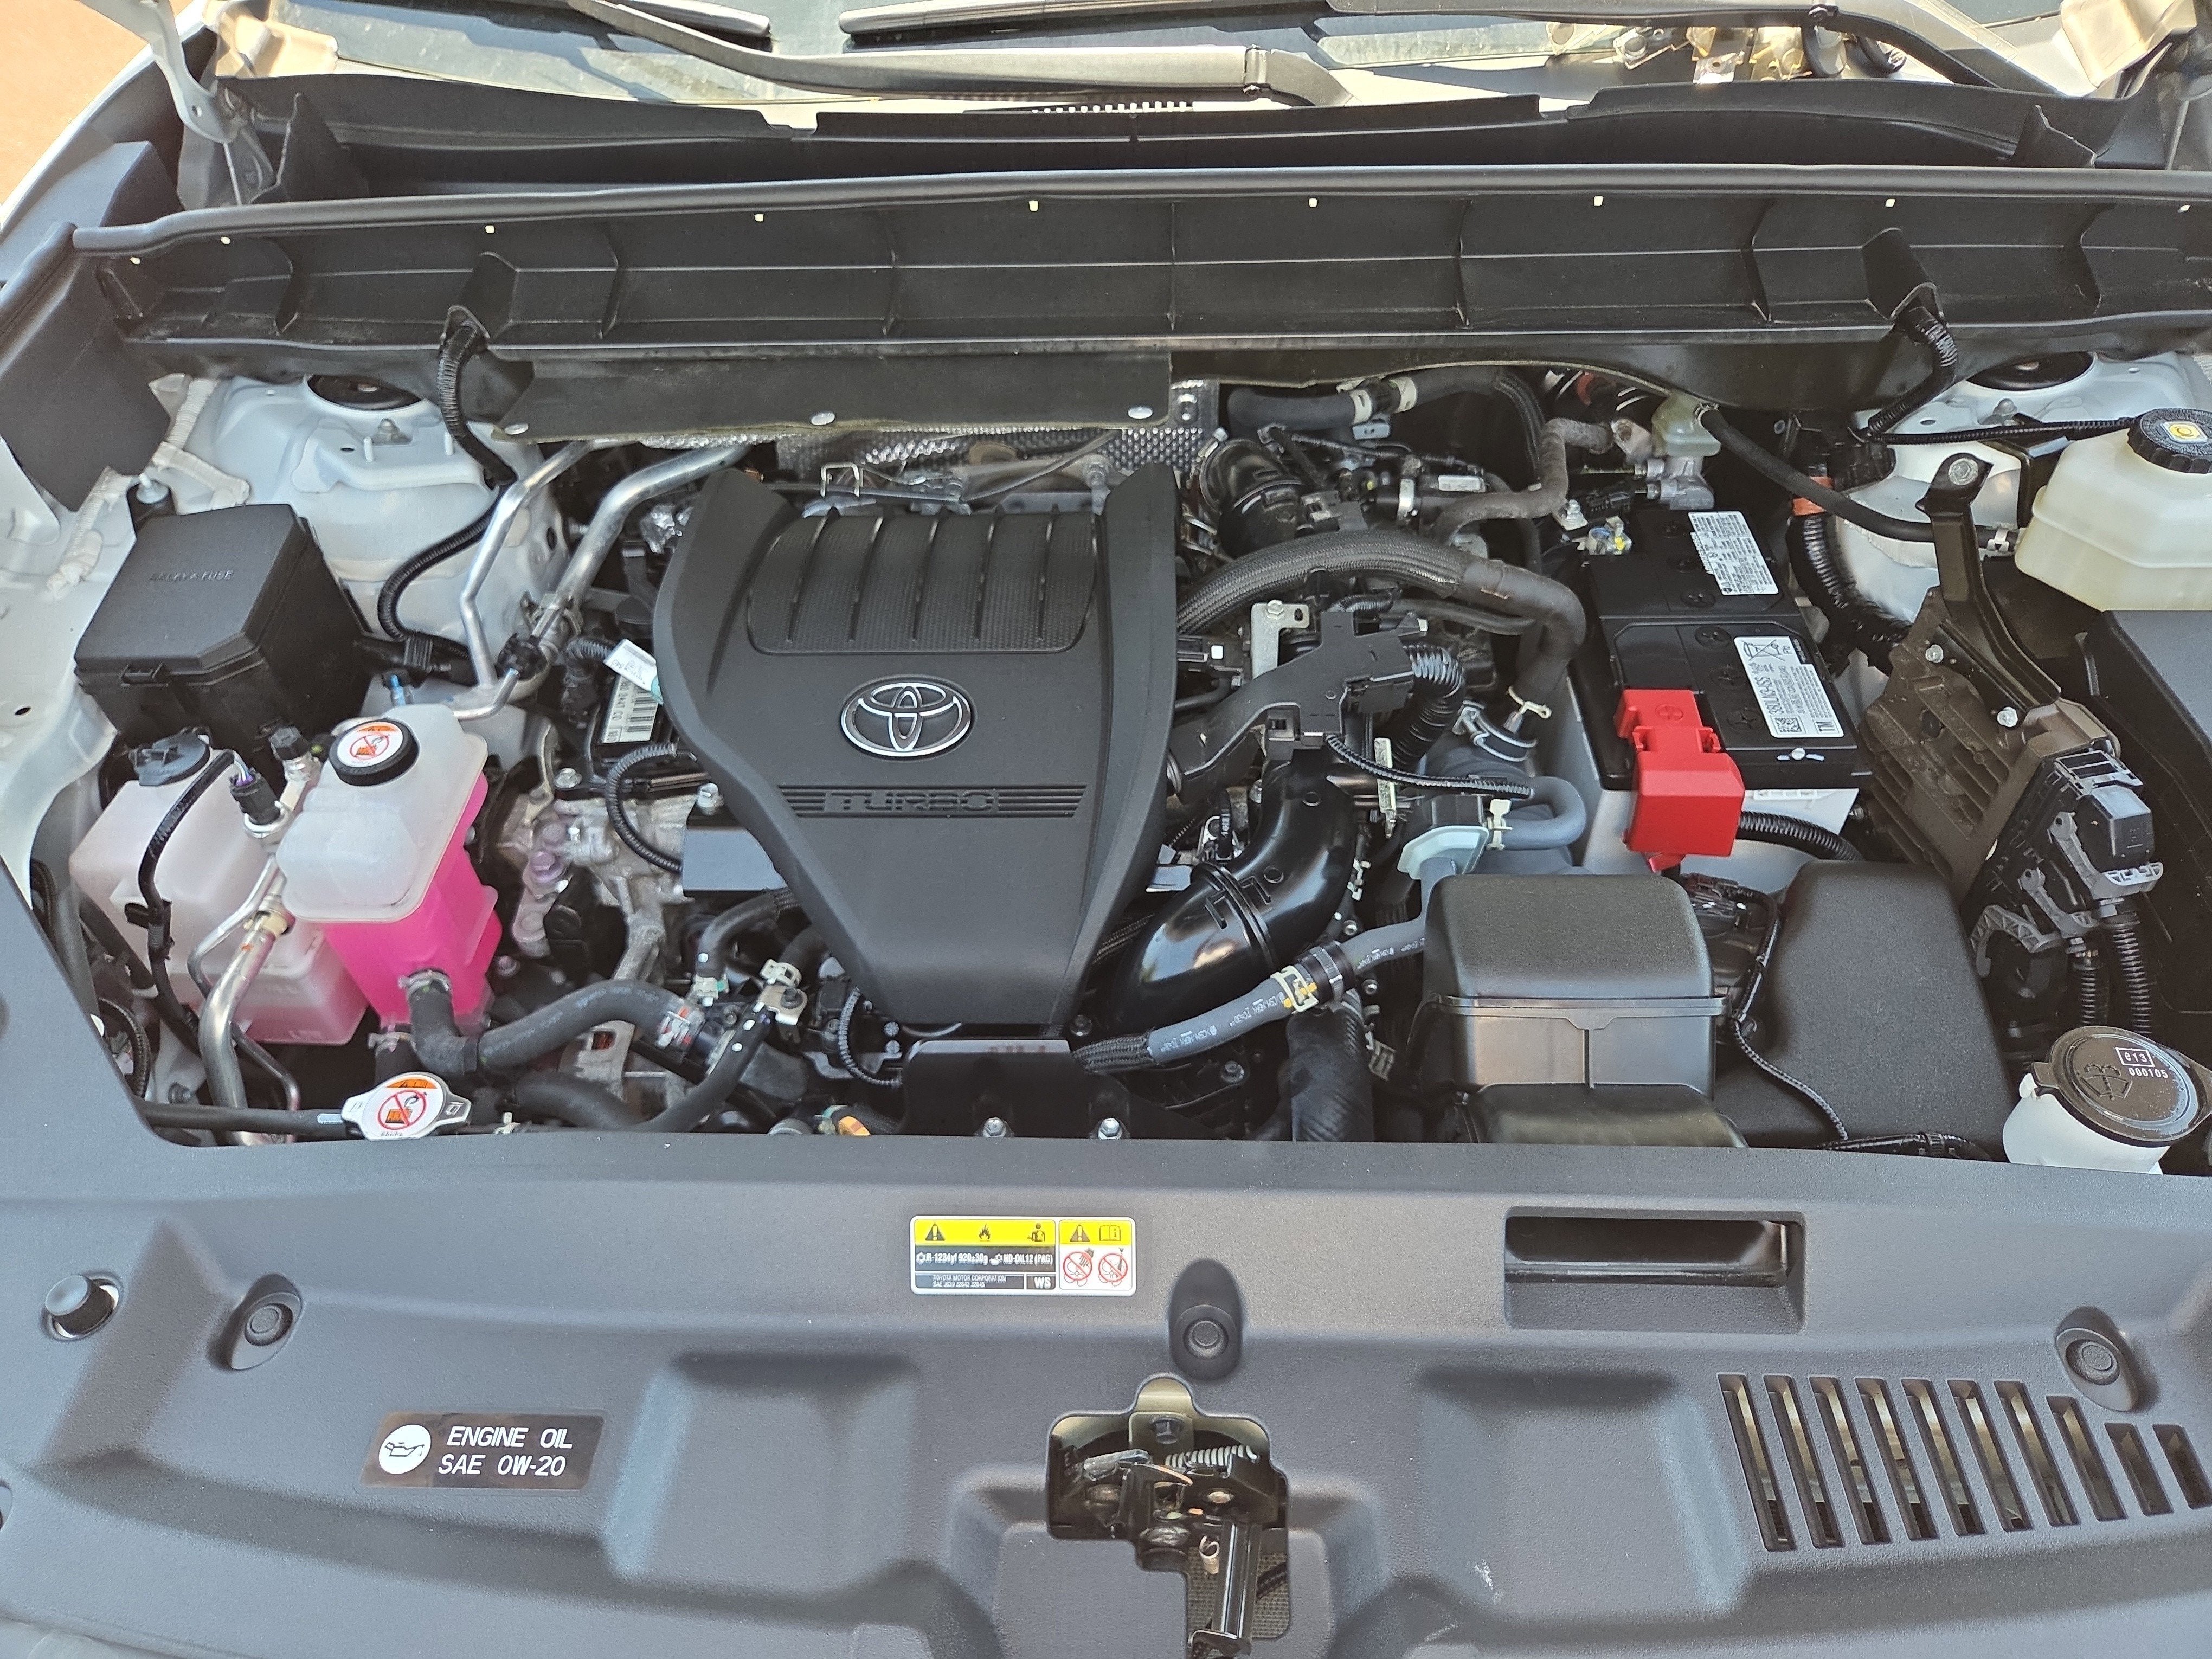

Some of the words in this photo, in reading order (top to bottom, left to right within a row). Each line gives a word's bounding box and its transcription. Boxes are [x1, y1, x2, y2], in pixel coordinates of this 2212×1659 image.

[831, 792, 996, 811] TURBO
[2124, 1052, 2147, 1063] e13
[2128, 1067, 2168, 1078] 000105
[1034, 1253, 1053, 1266] (PAG)
[972, 1275, 1006, 1283] CORPORATION
[1034, 1276, 1052, 1289] WS
[446, 1425, 529, 1448] ENGINE
[539, 1427, 573, 1449] OIL
[438, 1453, 486, 1475] SAE
[497, 1455, 566, 1476] 0W-20
